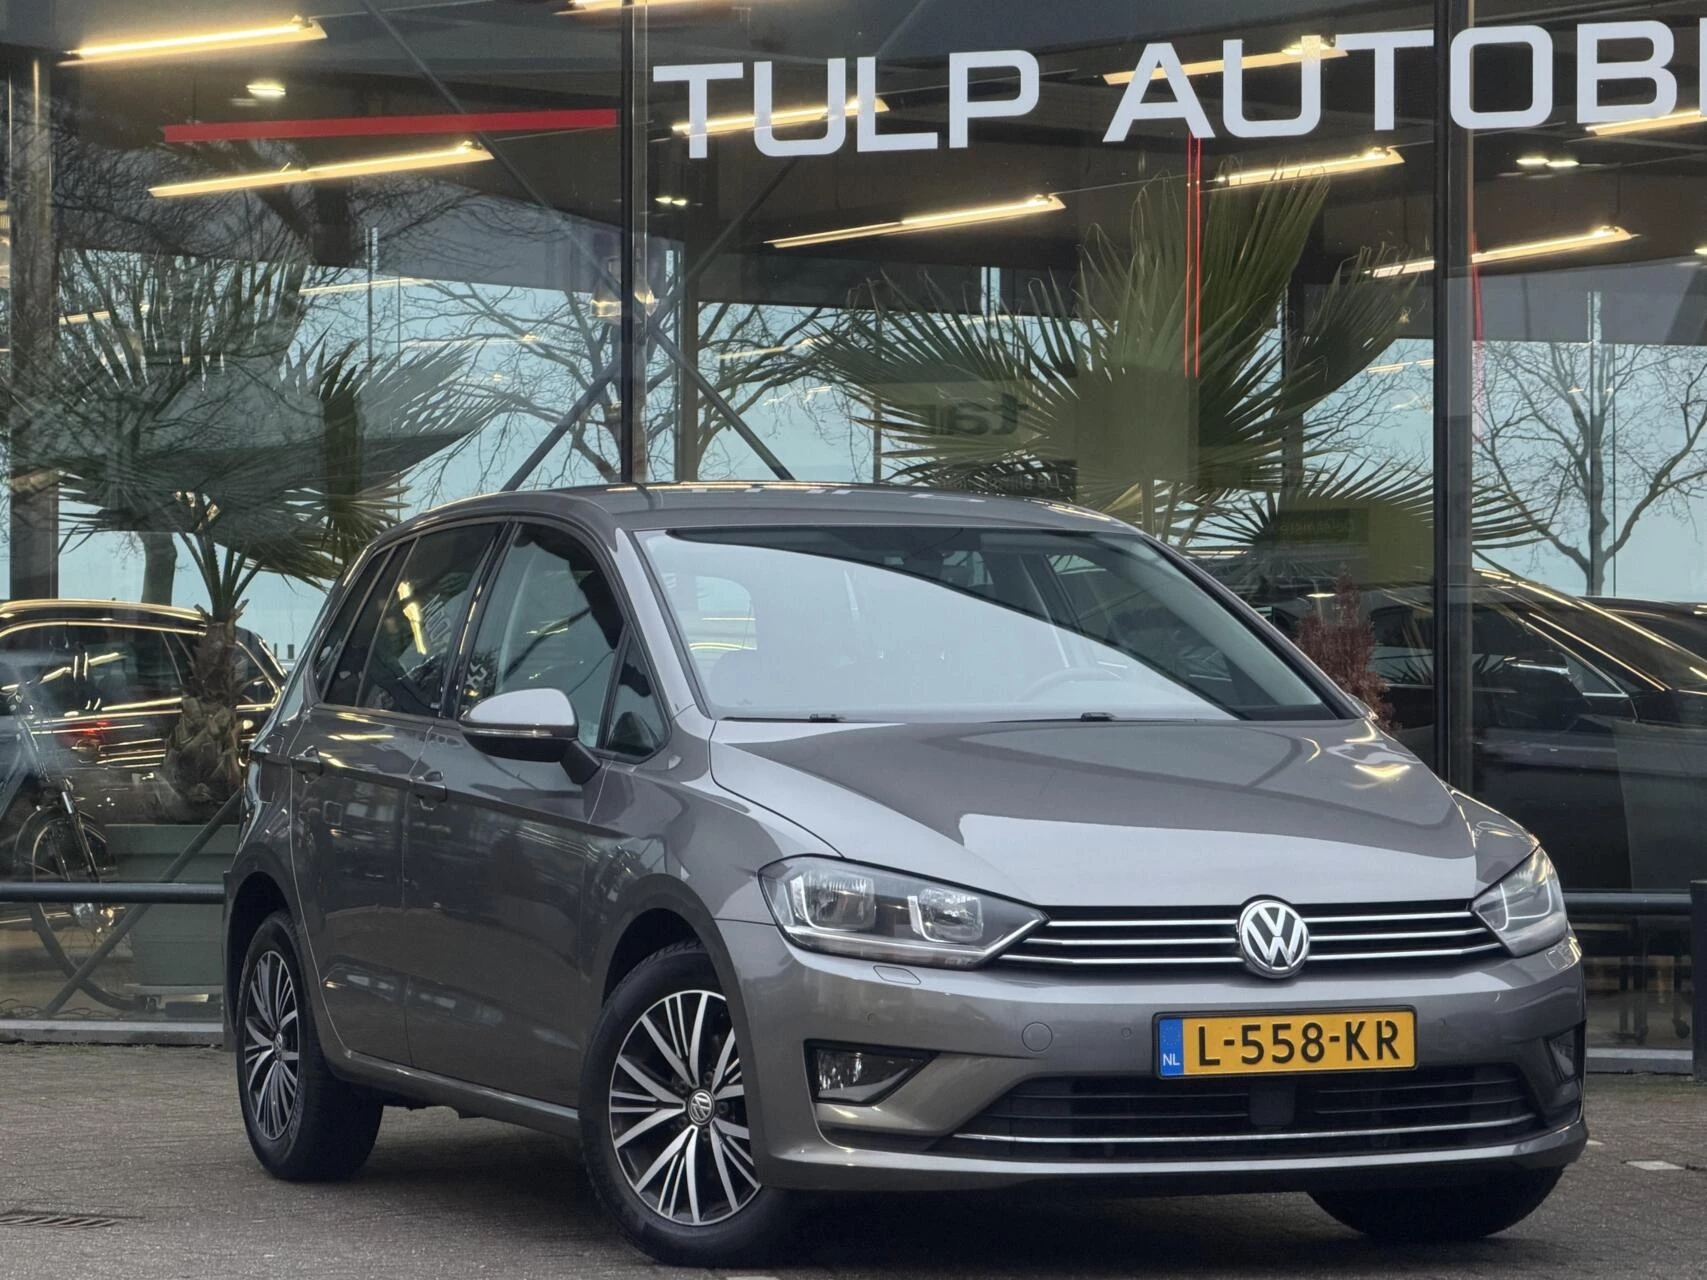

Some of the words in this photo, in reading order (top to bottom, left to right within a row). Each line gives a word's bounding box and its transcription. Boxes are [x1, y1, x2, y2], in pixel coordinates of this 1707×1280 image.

[653, 49, 1040, 159] TULP
[1102, 17, 1707, 143] AUTOB
[1162, 1053, 1181, 1067] NL
[1197, 1019, 1401, 1067] L-558-KR
